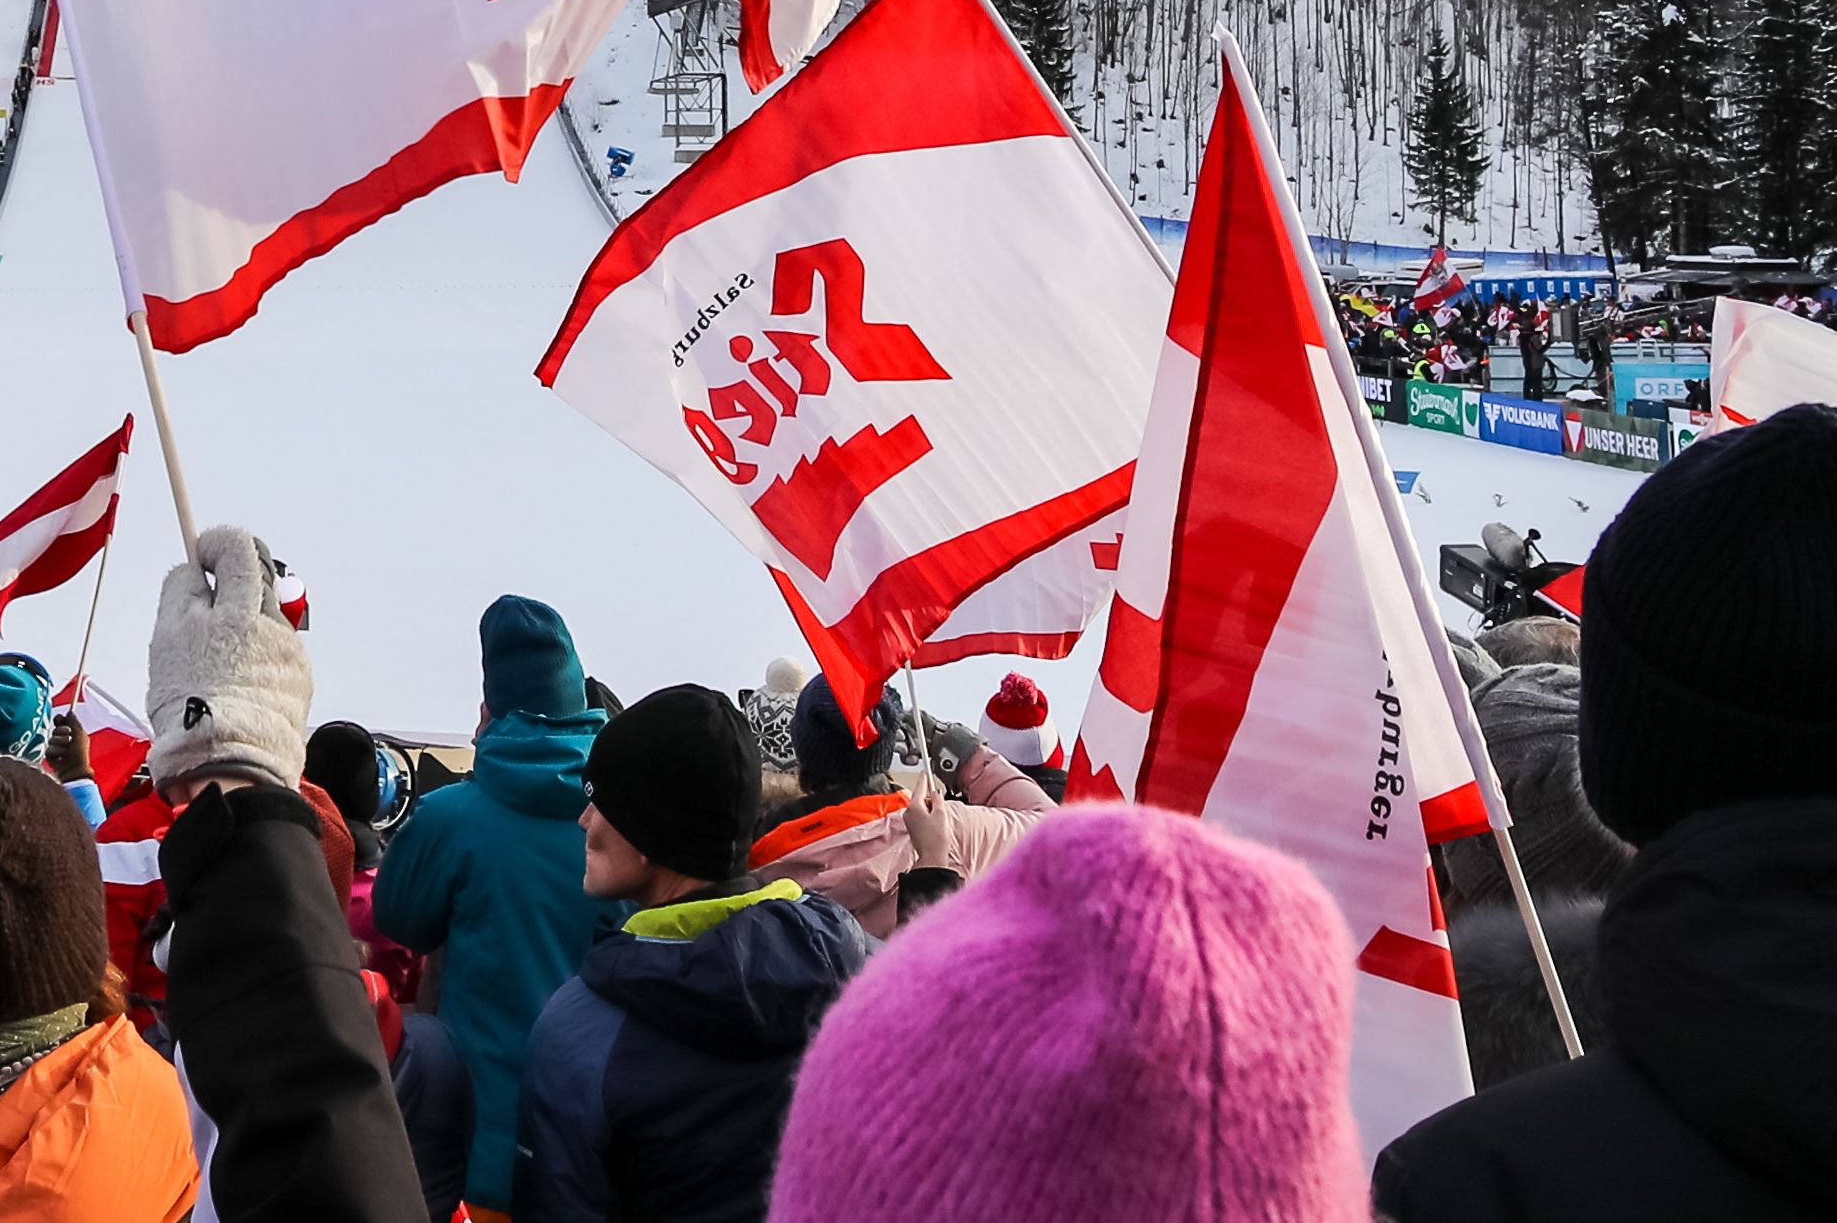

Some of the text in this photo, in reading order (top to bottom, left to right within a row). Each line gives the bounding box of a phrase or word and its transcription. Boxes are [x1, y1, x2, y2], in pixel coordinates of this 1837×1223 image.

[1640, 383, 1684, 395] ORF
[1501, 406, 1559, 431] VOLKSBANK
[1584, 426, 1625, 455] UNSER
[1627, 433, 1659, 460] HEER
